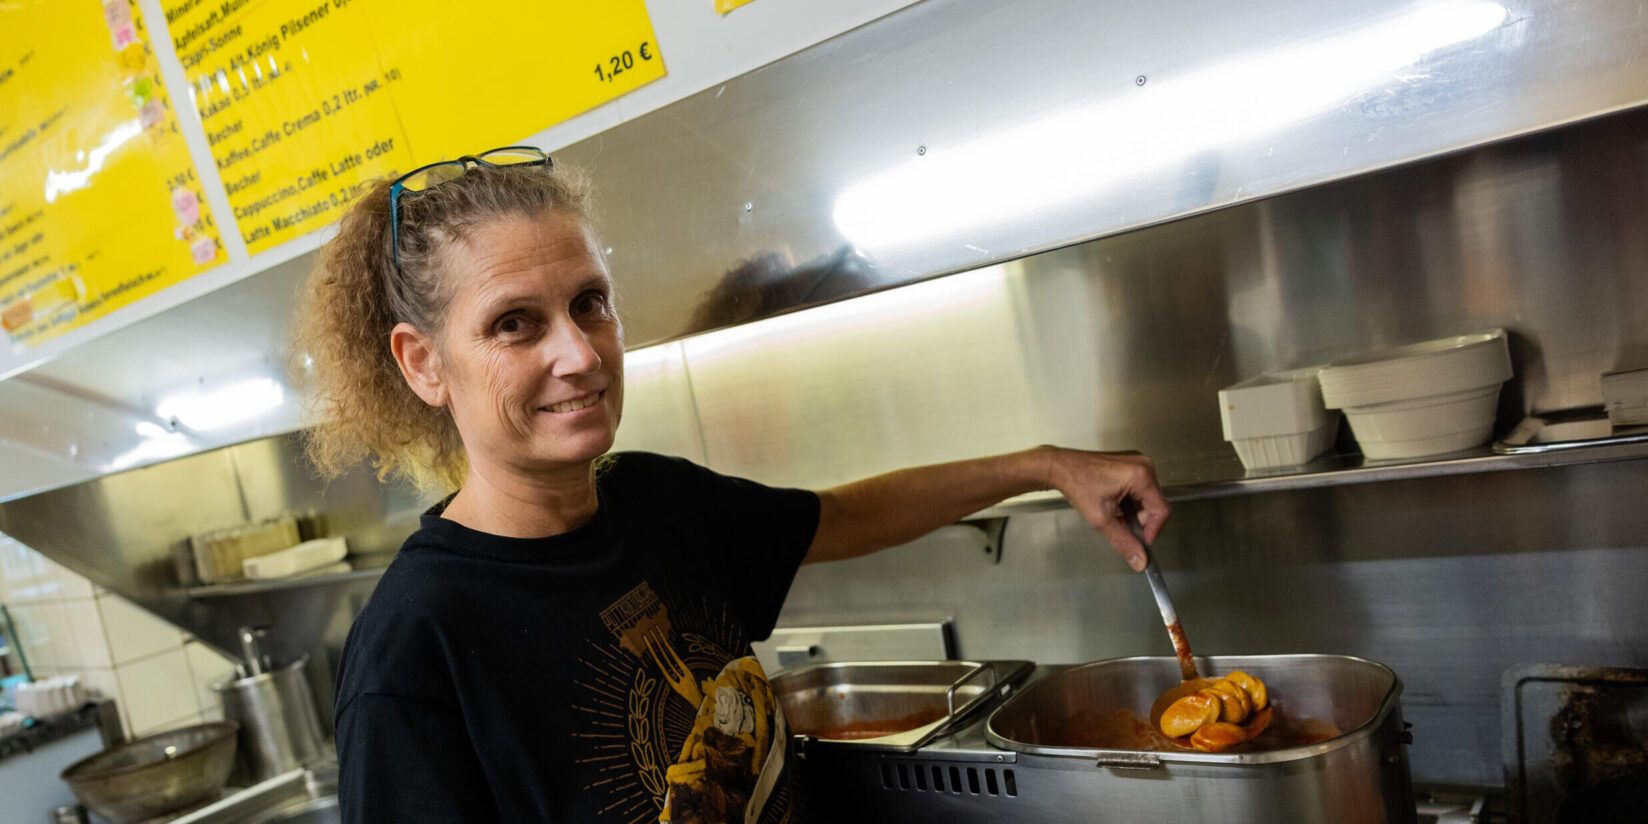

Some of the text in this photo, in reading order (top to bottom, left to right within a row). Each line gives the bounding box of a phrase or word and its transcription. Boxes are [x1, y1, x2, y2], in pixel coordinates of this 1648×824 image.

[280, 2, 330, 40] Pilsener
[594, 41, 652, 82] 1,20 €
[199, 95, 232, 120] Kakao
[208, 118, 243, 147] Becher
[217, 128, 282, 171] Kaffee,Caffe
[282, 109, 321, 137] Crema
[322, 95, 342, 118] 0,2
[343, 87, 363, 107] ltr.
[225, 170, 262, 197] Becher
[234, 164, 329, 221] Cappuccino,Caffe
[330, 149, 363, 177] Latte
[365, 136, 396, 161] oder
[242, 222, 271, 245] Latte
[271, 199, 330, 233] Macchiato
[330, 187, 350, 209] 0,2
